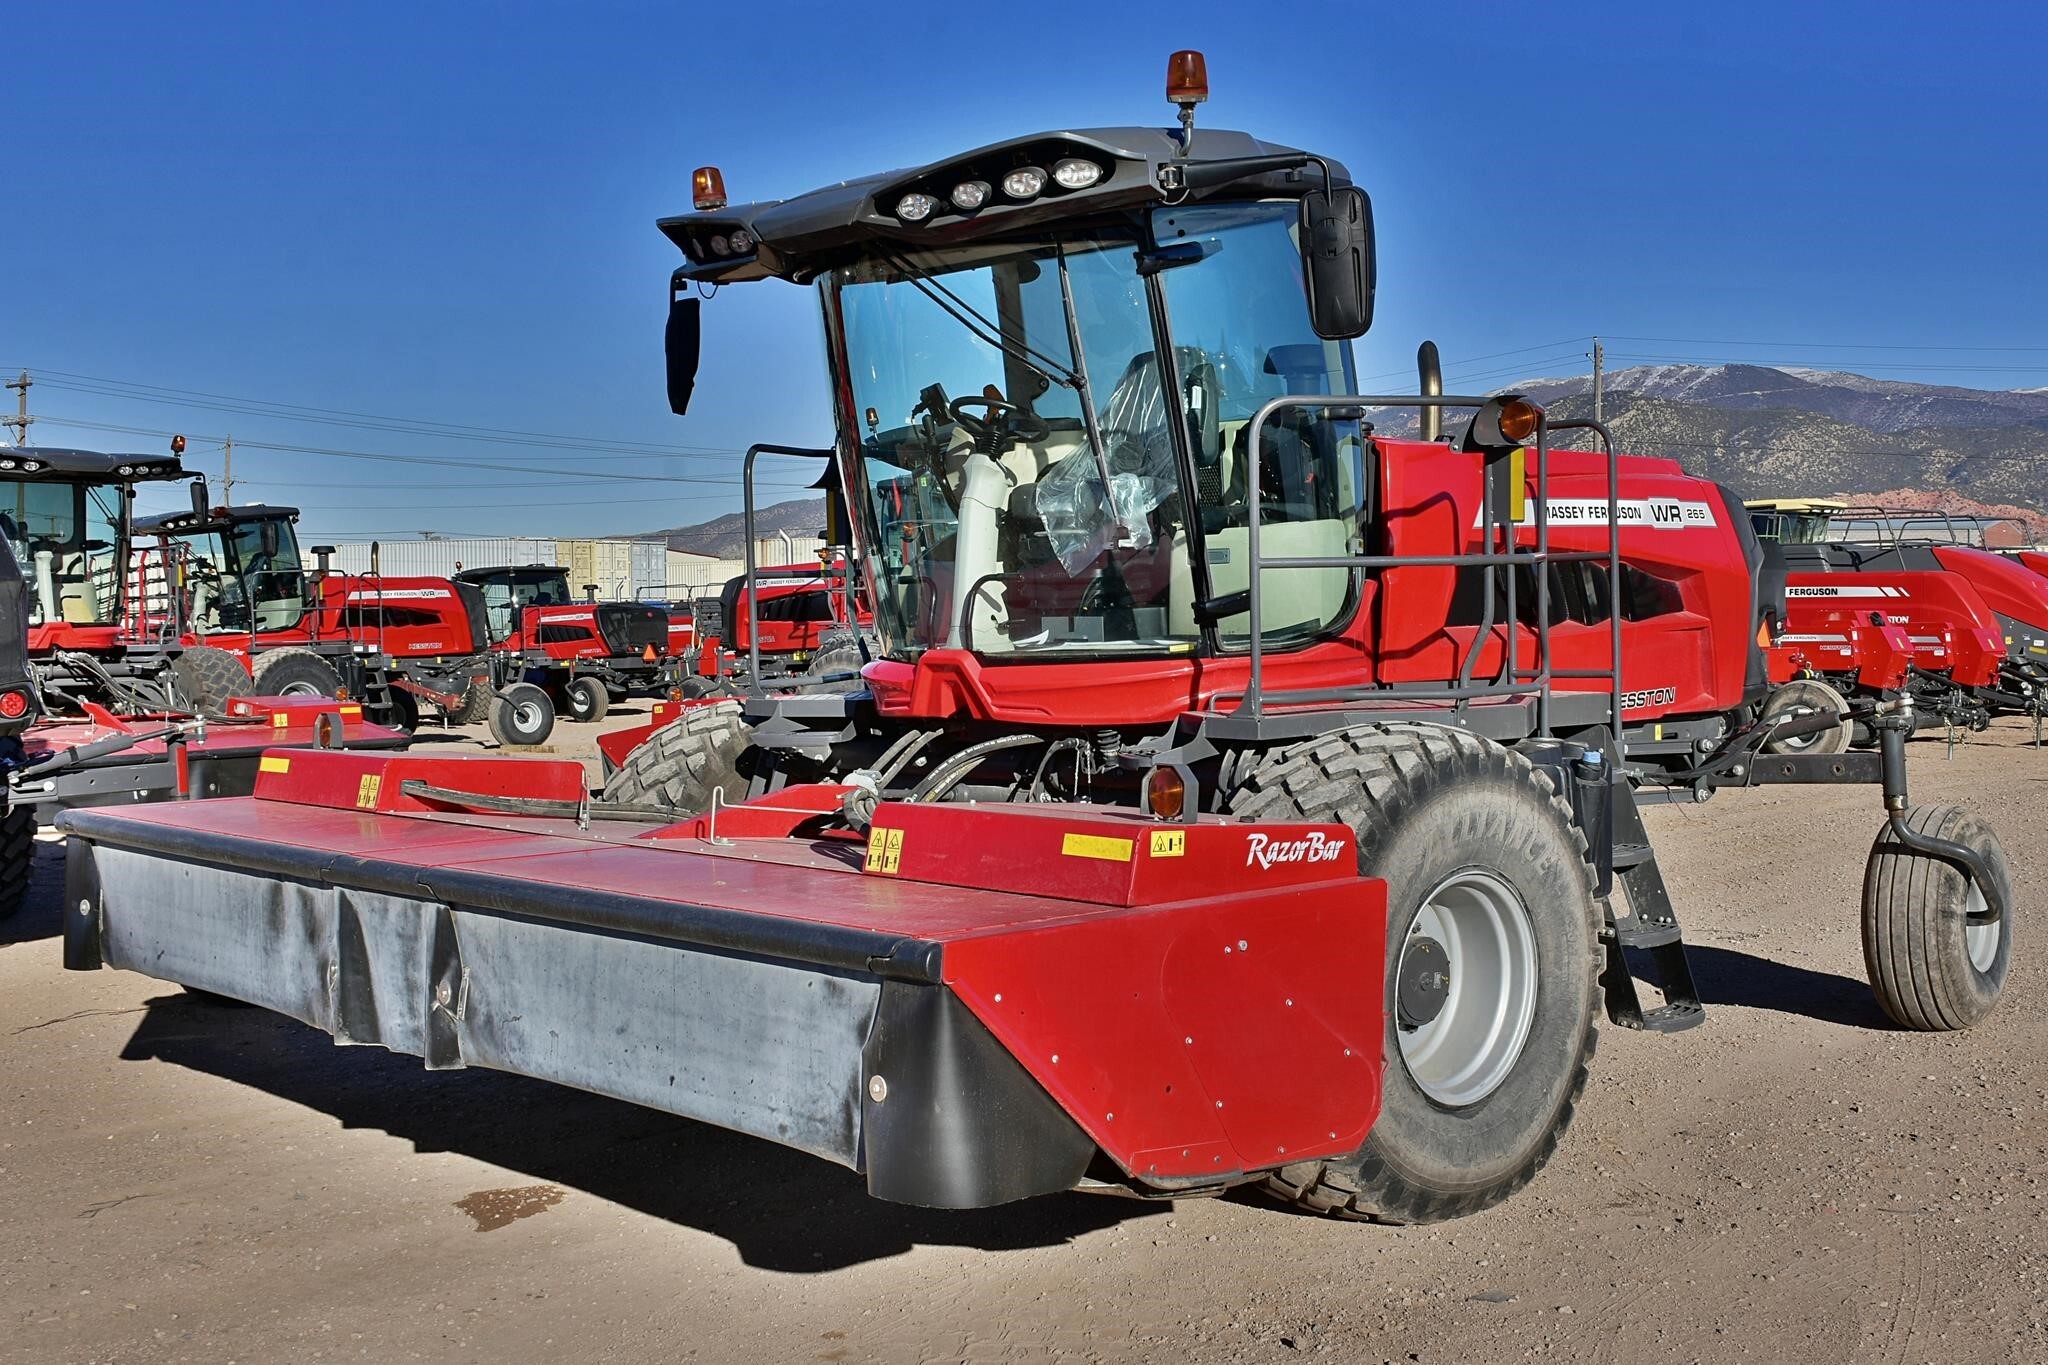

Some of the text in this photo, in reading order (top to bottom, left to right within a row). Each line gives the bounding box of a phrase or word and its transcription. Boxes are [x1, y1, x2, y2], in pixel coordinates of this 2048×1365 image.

[1588, 506, 1642, 519] FERUSON
[1650, 504, 1682, 522] WR
[1686, 508, 1706, 519] 265
[1789, 588, 1838, 596] FERGUSON
[1621, 686, 1676, 711] ESSTON
